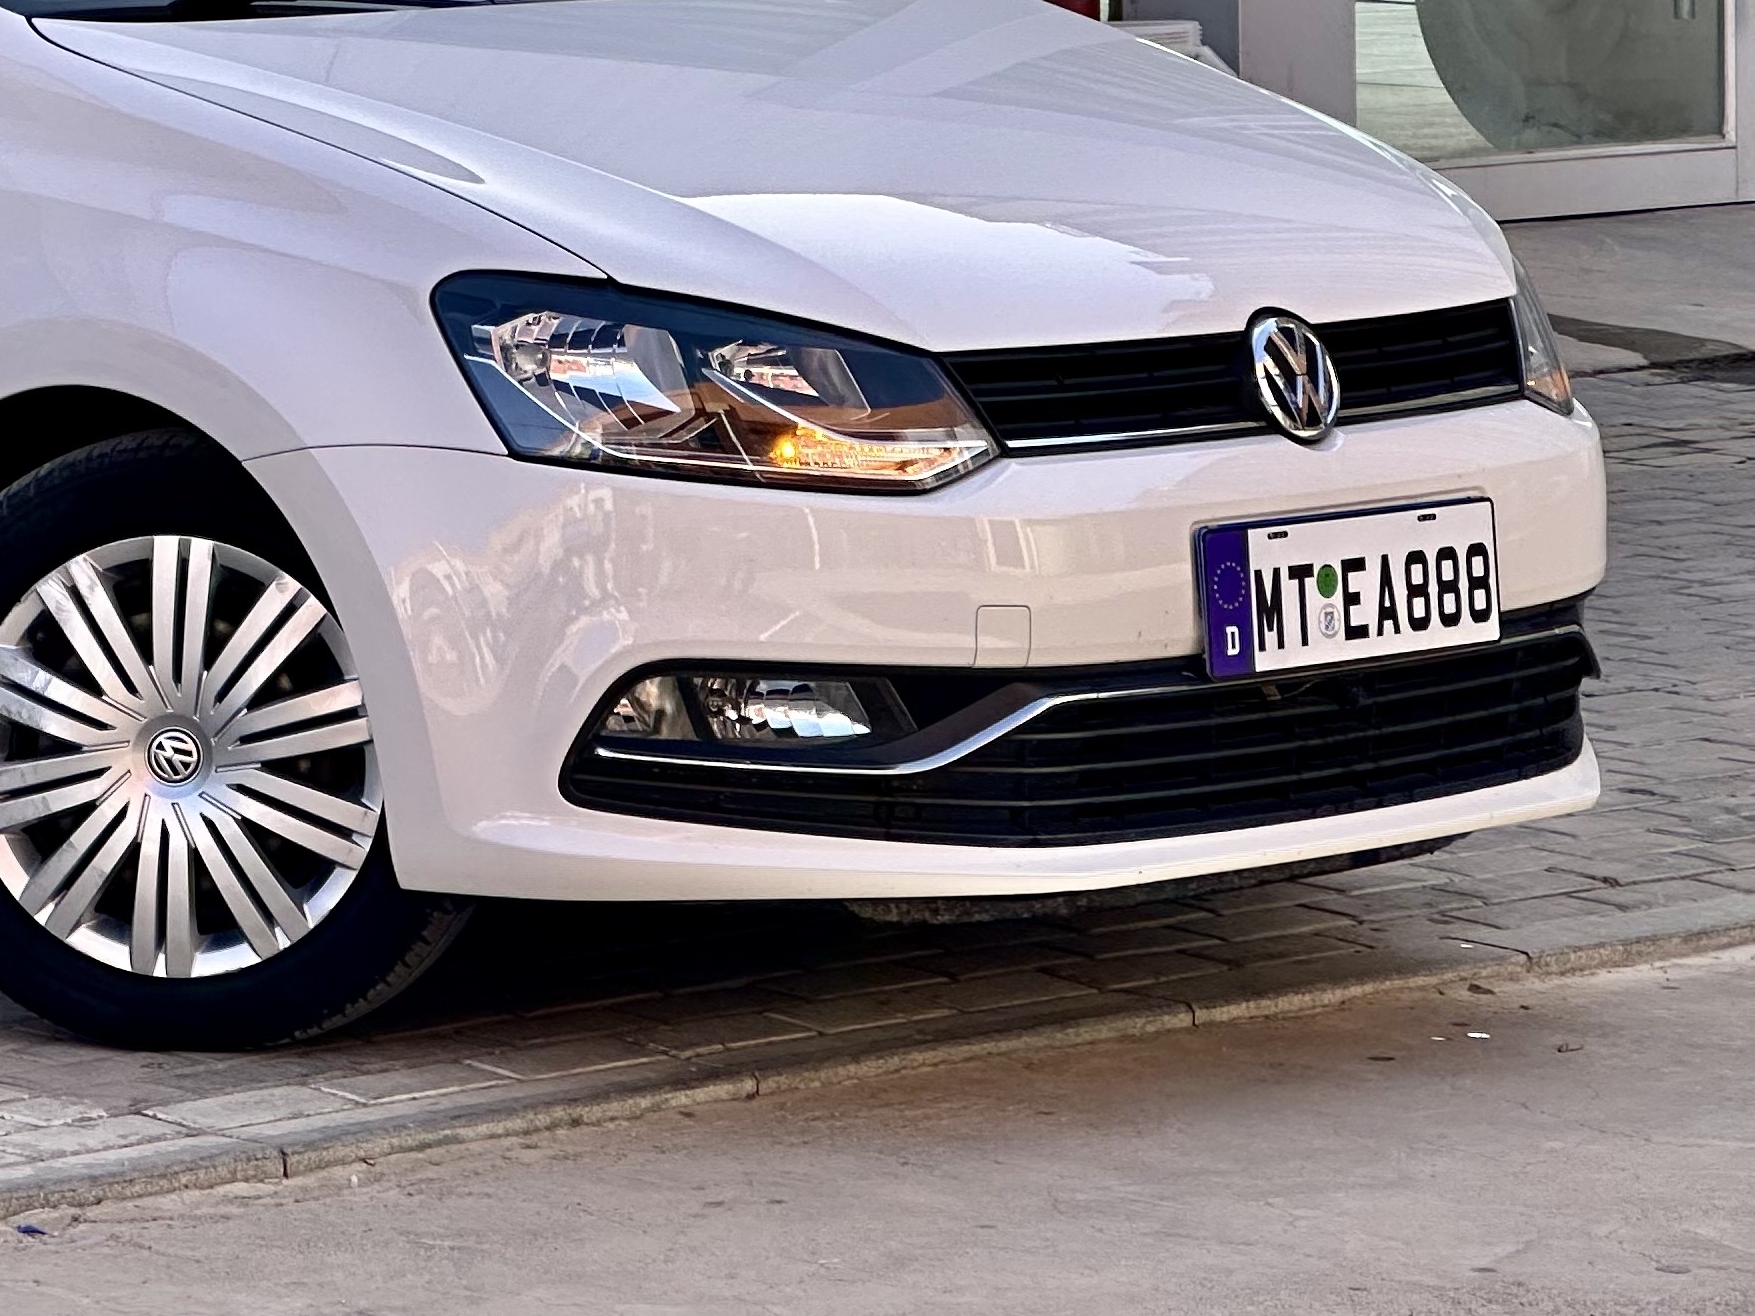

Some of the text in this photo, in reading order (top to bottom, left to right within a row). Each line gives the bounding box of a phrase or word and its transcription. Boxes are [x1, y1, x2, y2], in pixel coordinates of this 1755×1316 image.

[1254, 542, 1493, 652] MT EA888
[1225, 625, 1240, 656] D
